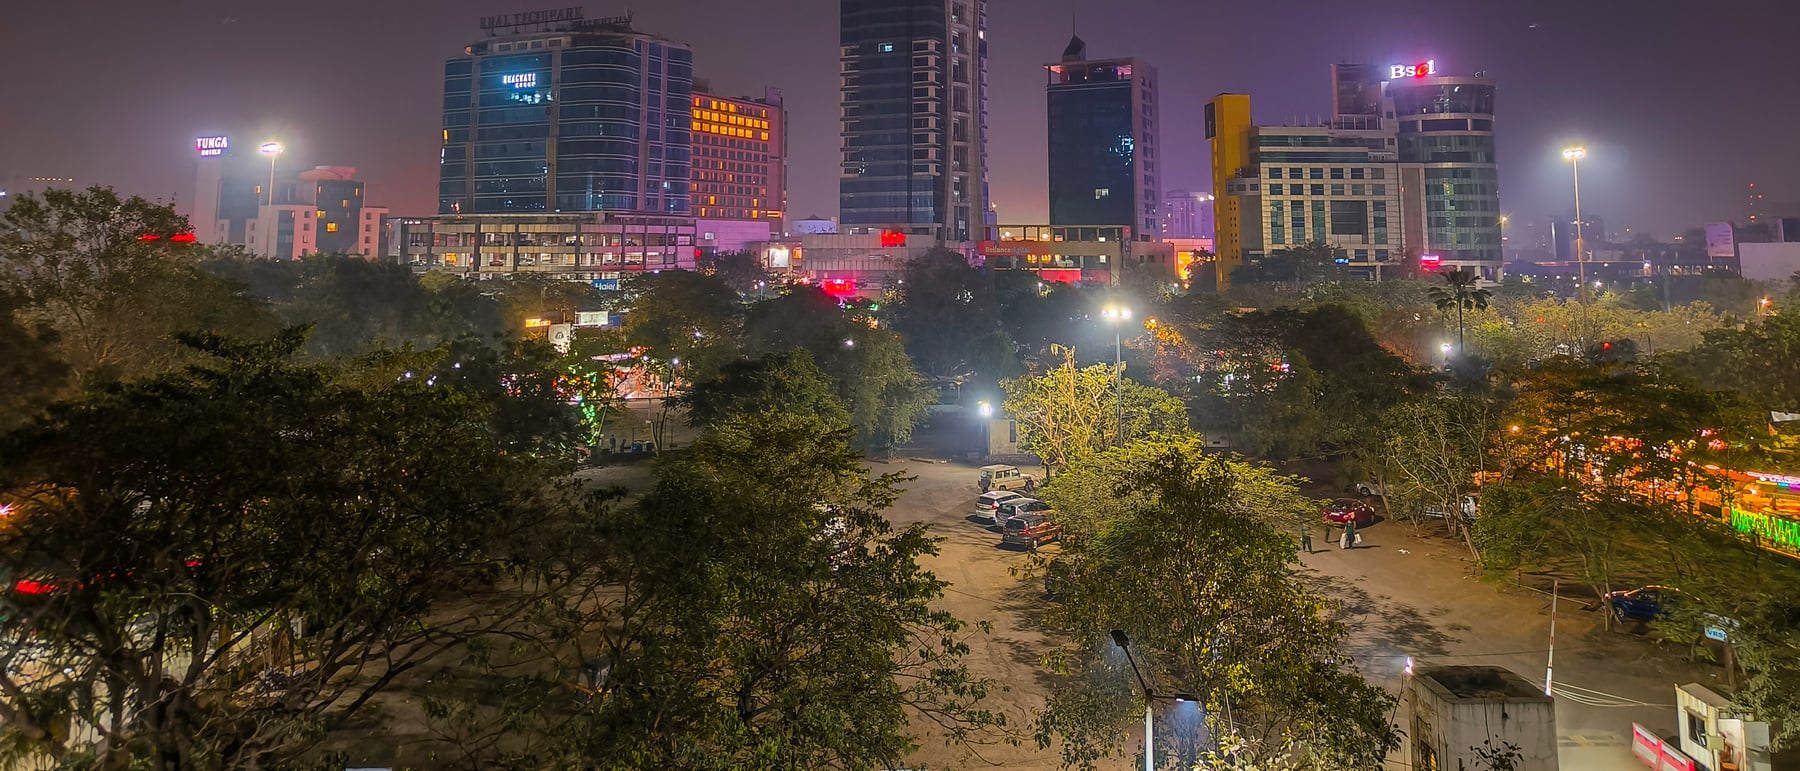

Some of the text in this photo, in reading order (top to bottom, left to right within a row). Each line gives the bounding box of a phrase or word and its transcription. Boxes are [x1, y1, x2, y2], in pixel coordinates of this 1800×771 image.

[196, 137, 227, 149] TUNGA
[985, 246, 1011, 254] Reliance
[595, 282, 616, 290] Haier
